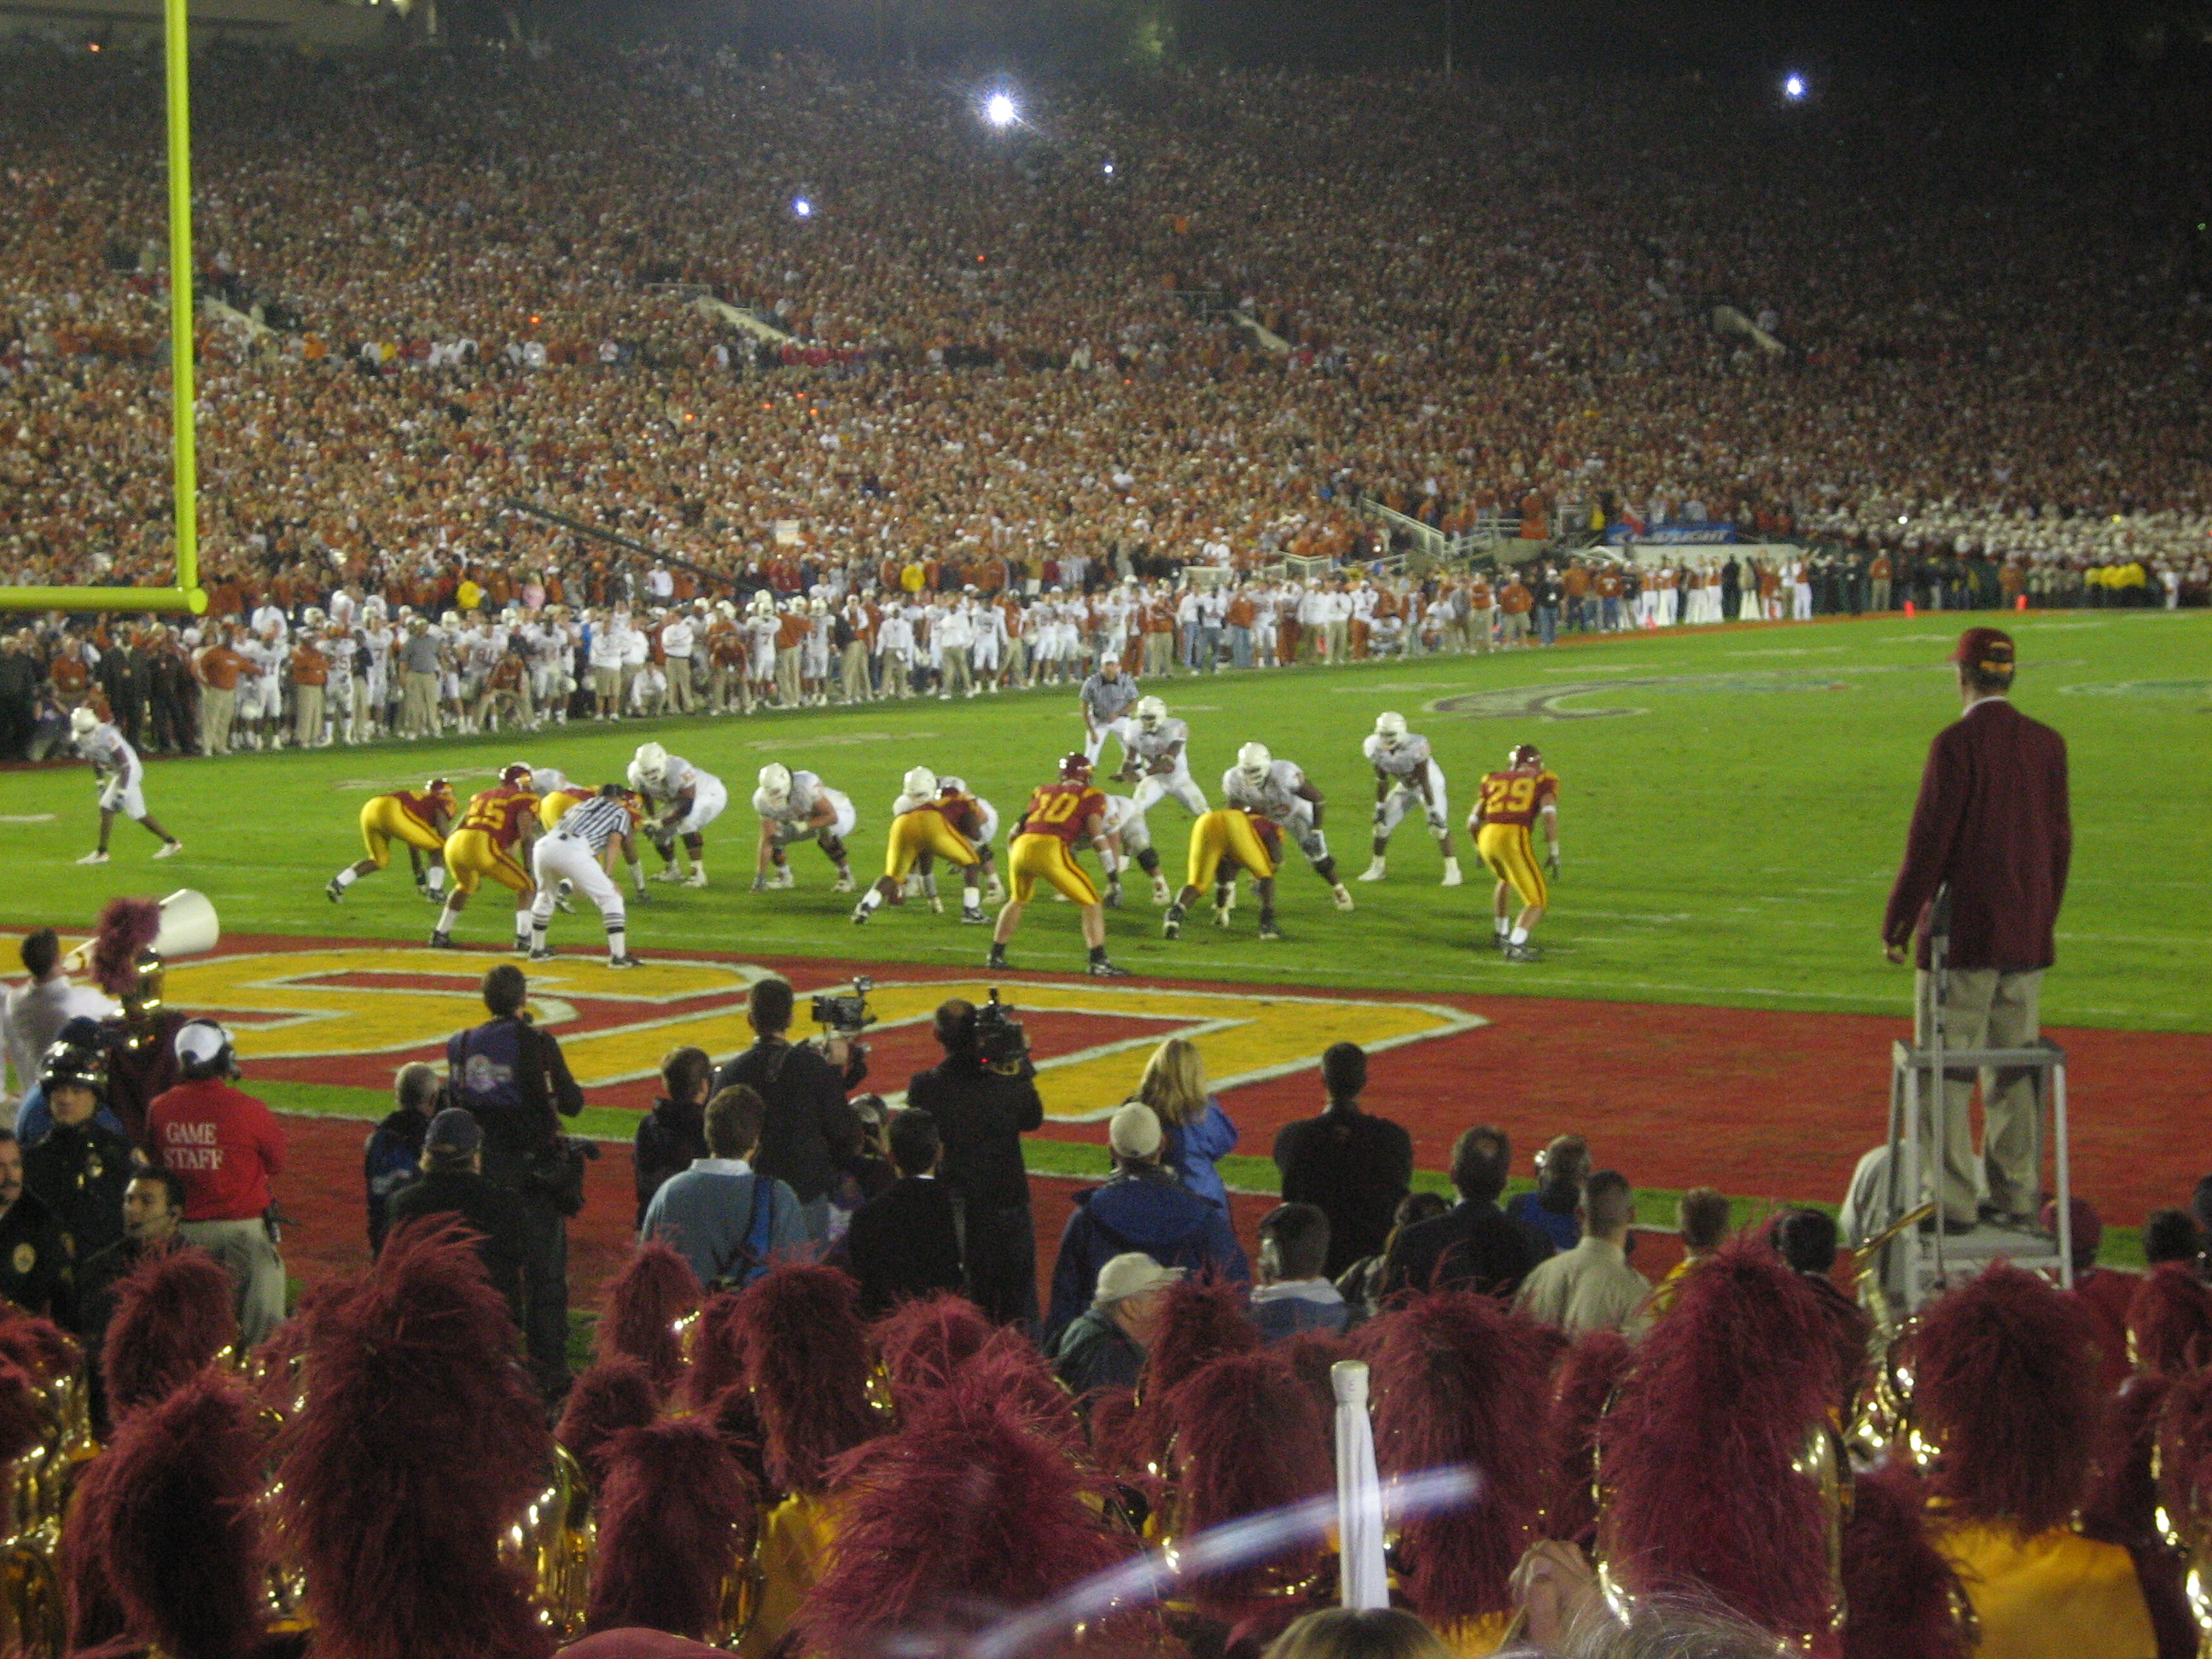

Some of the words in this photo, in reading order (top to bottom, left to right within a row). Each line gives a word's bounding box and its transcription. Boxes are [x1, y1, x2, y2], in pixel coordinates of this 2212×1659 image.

[1026, 792, 1080, 824] 10
[1485, 777, 1536, 813] 29
[166, 1121, 218, 1144] GAME
[162, 1147, 224, 1170] STAFF
